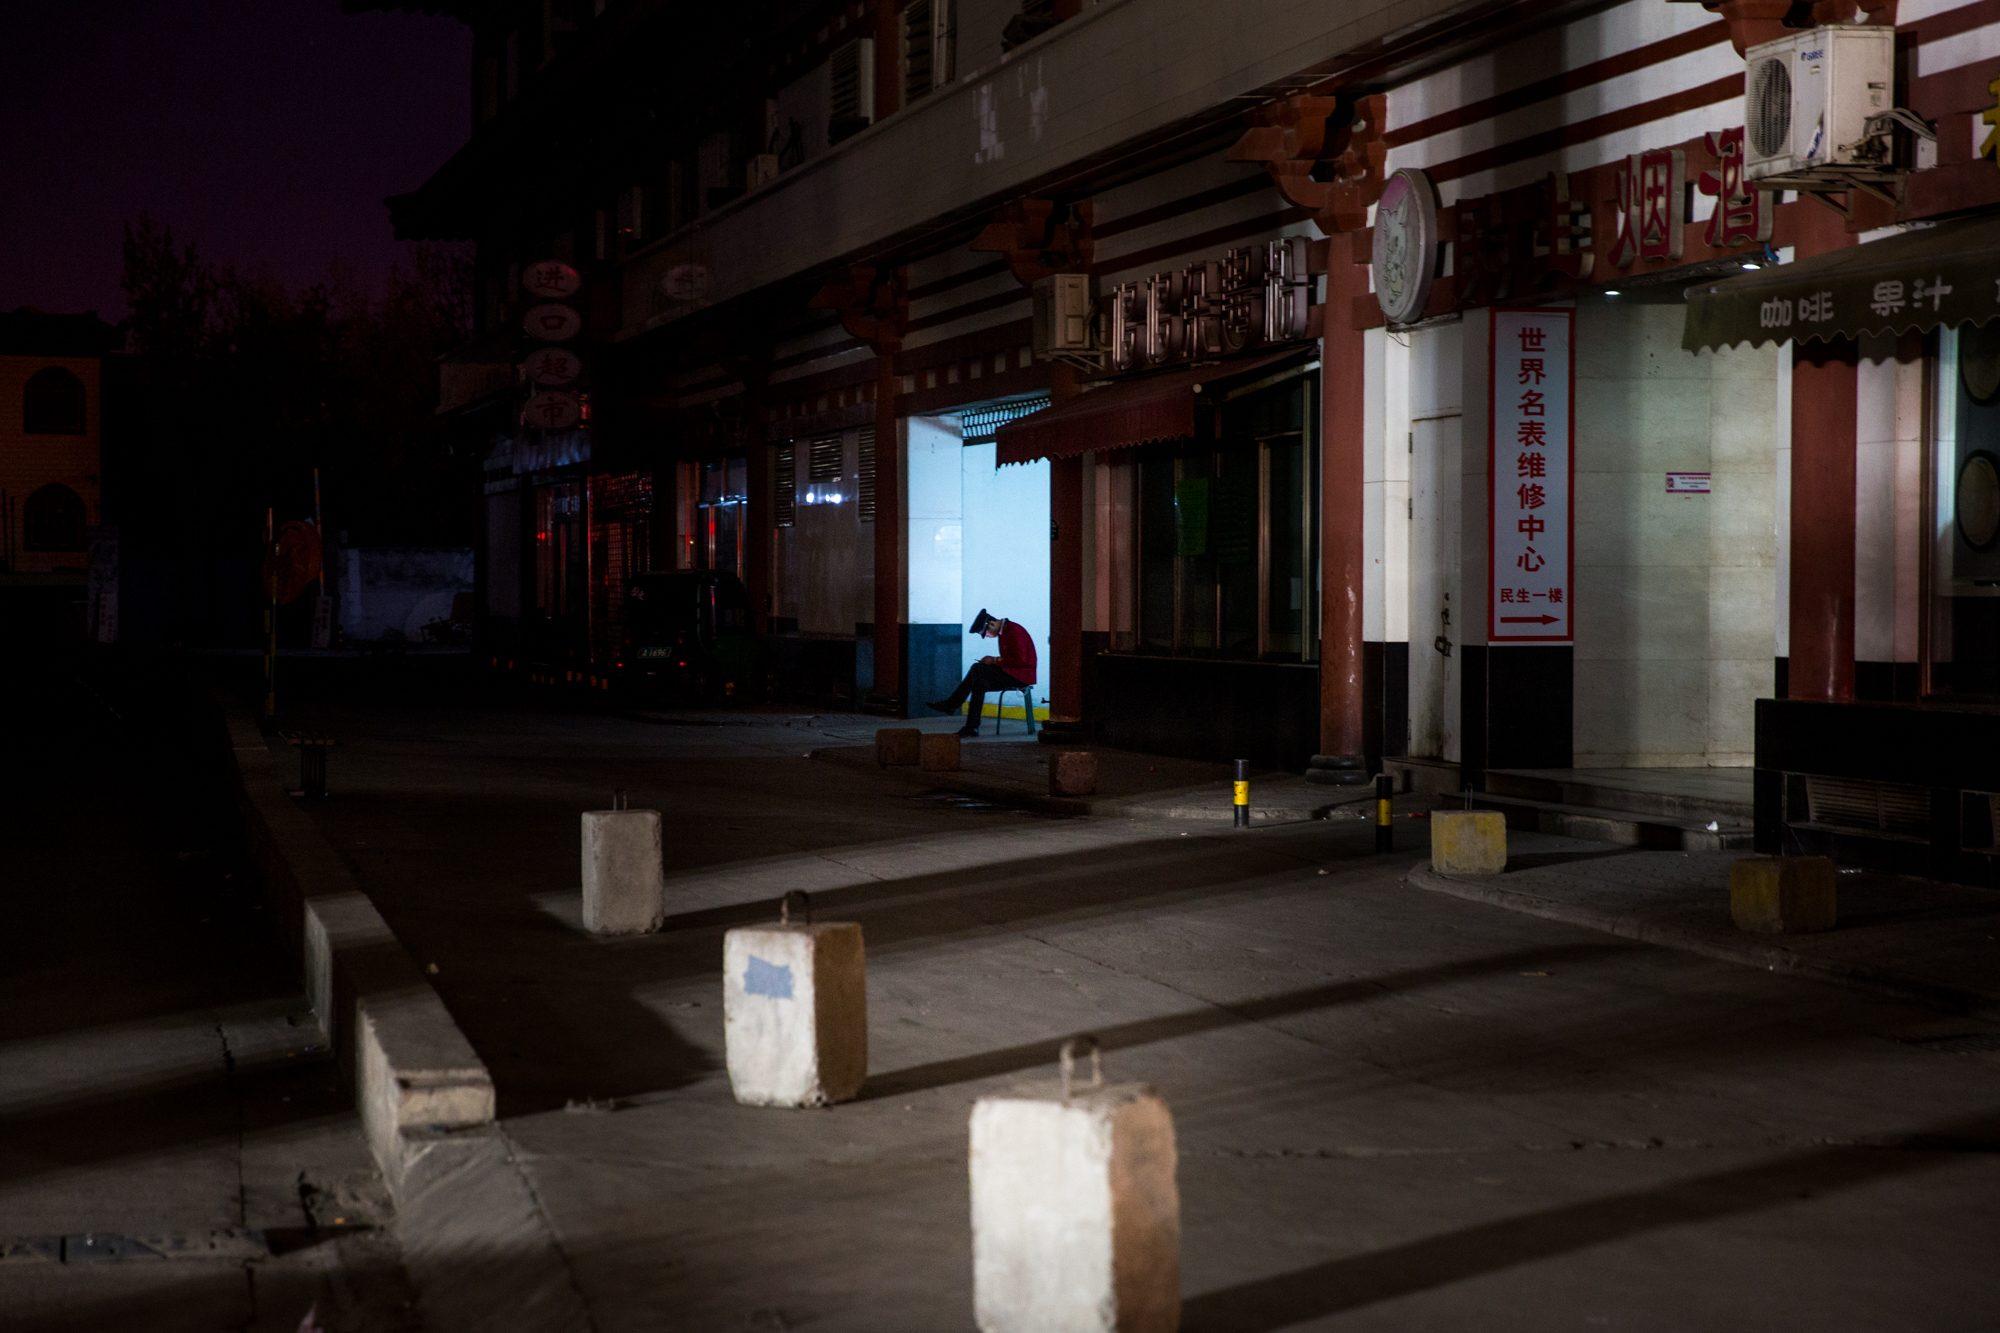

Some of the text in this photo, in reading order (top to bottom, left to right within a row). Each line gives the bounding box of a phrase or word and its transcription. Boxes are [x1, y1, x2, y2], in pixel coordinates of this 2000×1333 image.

[1760, 291, 1834, 328] 咖啡
[1870, 275, 1953, 317] 果汁
[1517, 327, 1547, 572] 世界名表维修中心
[1500, 587, 1564, 603] 民生一楼
